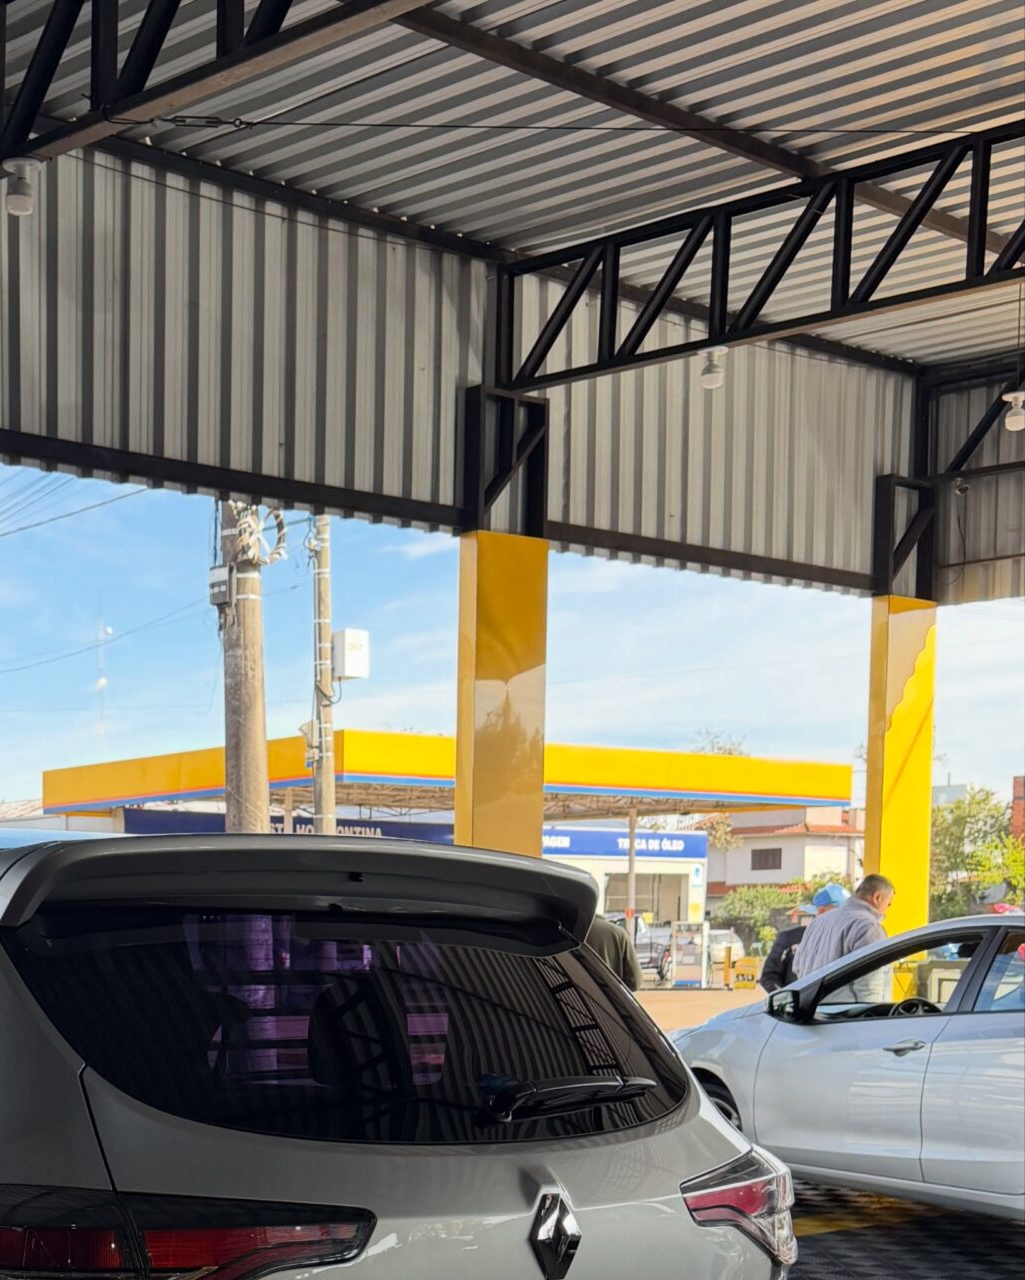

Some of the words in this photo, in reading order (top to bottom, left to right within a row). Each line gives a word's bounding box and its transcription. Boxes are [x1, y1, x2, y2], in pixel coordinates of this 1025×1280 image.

[617, 838, 647, 850] TRCA
[648, 839, 660, 850] DE
[661, 837, 685, 851] ÓLEO
